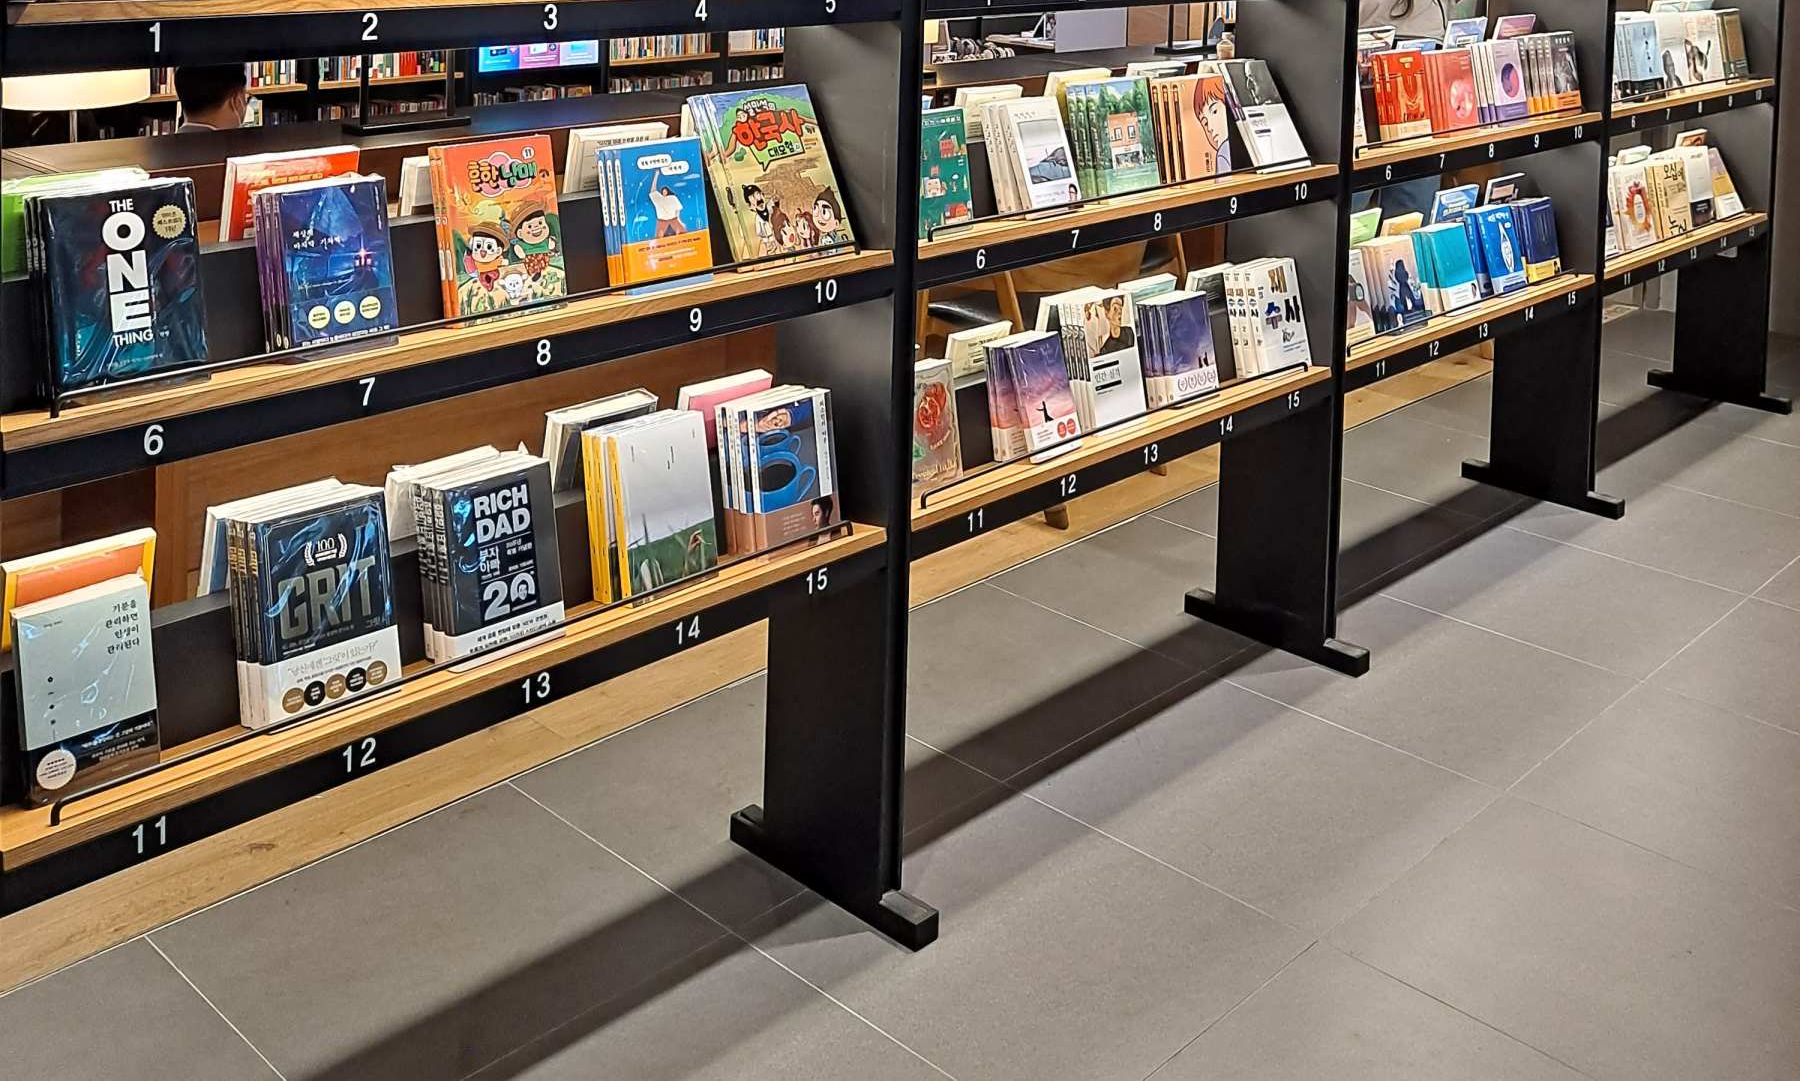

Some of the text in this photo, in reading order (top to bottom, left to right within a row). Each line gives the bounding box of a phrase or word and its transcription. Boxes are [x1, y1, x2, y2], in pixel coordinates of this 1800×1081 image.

[360, 11, 379, 40] 2
[544, 4, 557, 29] 3
[150, 19, 165, 52] 1
[735, 108, 805, 151] 한국사
[1574, 125, 1583, 139] 10
[767, 141, 795, 157] 대모험
[1488, 143, 1495, 158] 8
[1534, 134, 1540, 149] 9
[1439, 153, 1445, 169] 7
[1384, 164, 1392, 182] 6
[1294, 182, 1308, 201] 10
[109, 198, 134, 213] THE
[1229, 196, 1238, 215] 9
[1153, 212, 1162, 232] 8
[1071, 229, 1080, 249] 7
[976, 248, 986, 270] 6
[102, 211, 153, 333] ONE
[815, 279, 837, 303] 10
[1566, 290, 1576, 306] 15
[688, 306, 703, 332] 9
[1525, 306, 1534, 322] 14
[112, 329, 154, 347] THING
[1478, 322, 1488, 339] 13
[535, 338, 552, 365] 8
[1429, 340, 1440, 357] 12
[1376, 360, 1386, 377] 11
[359, 377, 375, 406] 7
[1287, 390, 1300, 410] 15
[1219, 415, 1233, 436] 14
[144, 425, 163, 455] 6
[1142, 442, 1159, 465] 13
[1060, 473, 1077, 497] 12
[473, 484, 529, 519] RICH
[476, 507, 531, 544] DAD
[967, 508, 983, 532] 11
[316, 537, 335, 552] 100
[807, 568, 827, 594] 15
[112, 599, 137, 612] 기분을
[277, 555, 376, 640] GRIT
[675, 615, 700, 644] 14
[522, 672, 550, 703] 13
[343, 738, 376, 772] 12
[133, 816, 165, 853] 11
